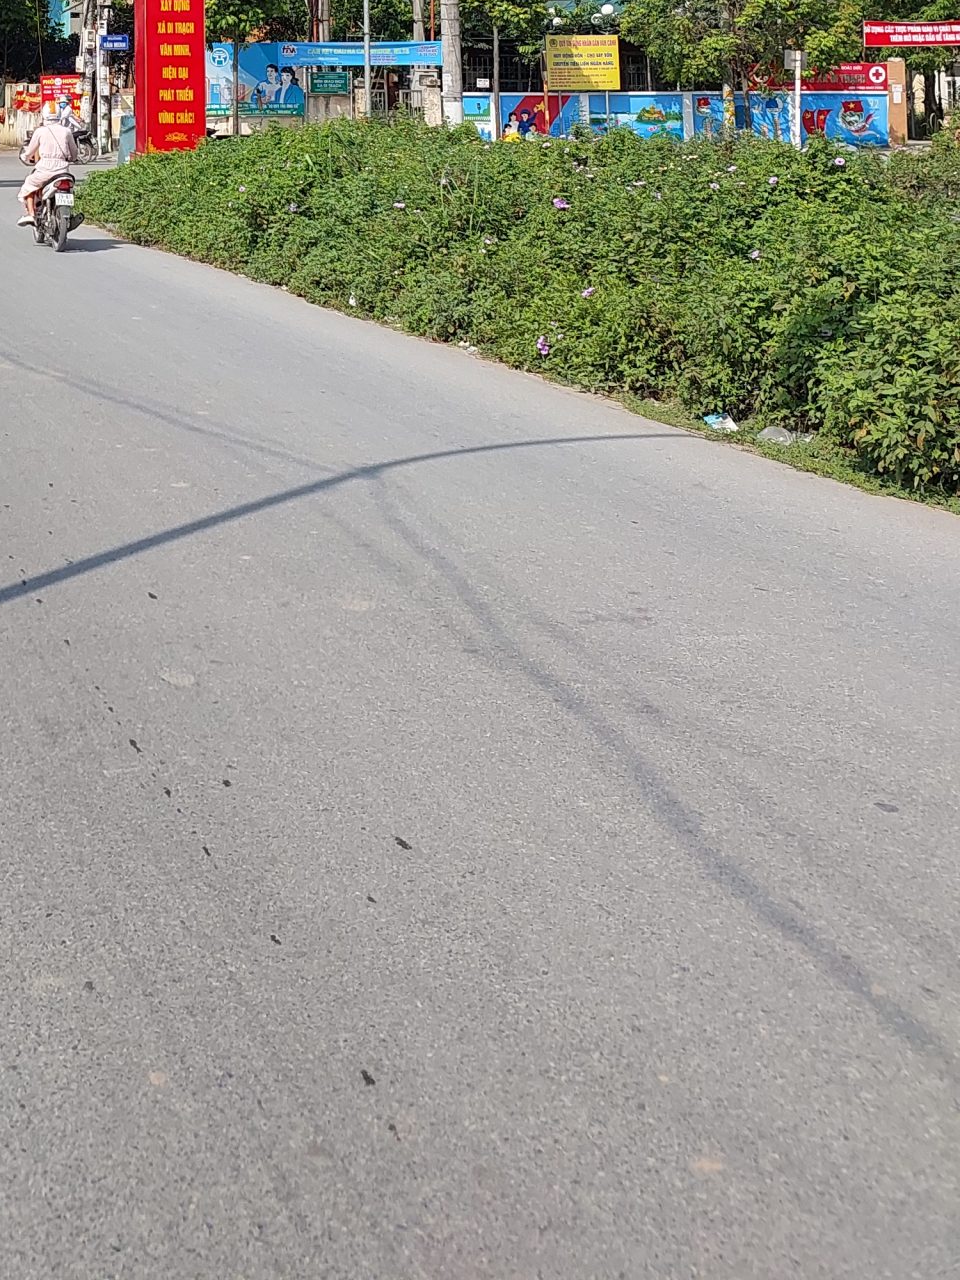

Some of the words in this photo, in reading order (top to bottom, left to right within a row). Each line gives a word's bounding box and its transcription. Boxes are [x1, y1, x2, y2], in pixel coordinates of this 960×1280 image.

[157, 20, 166, 34] XÃ
[167, 22, 174, 34] DI
[174, 22, 194, 35] TRẠCH
[160, 43, 172, 56] VĂN
[162, 65, 176, 80] HIỆN
[178, 67, 188, 80] ĐẠI
[159, 88, 174, 101] PHÁT
[176, 86, 194, 101] TRIỂN
[158, 110, 174, 124] VỮNG
[176, 108, 195, 124] CHẮC!
